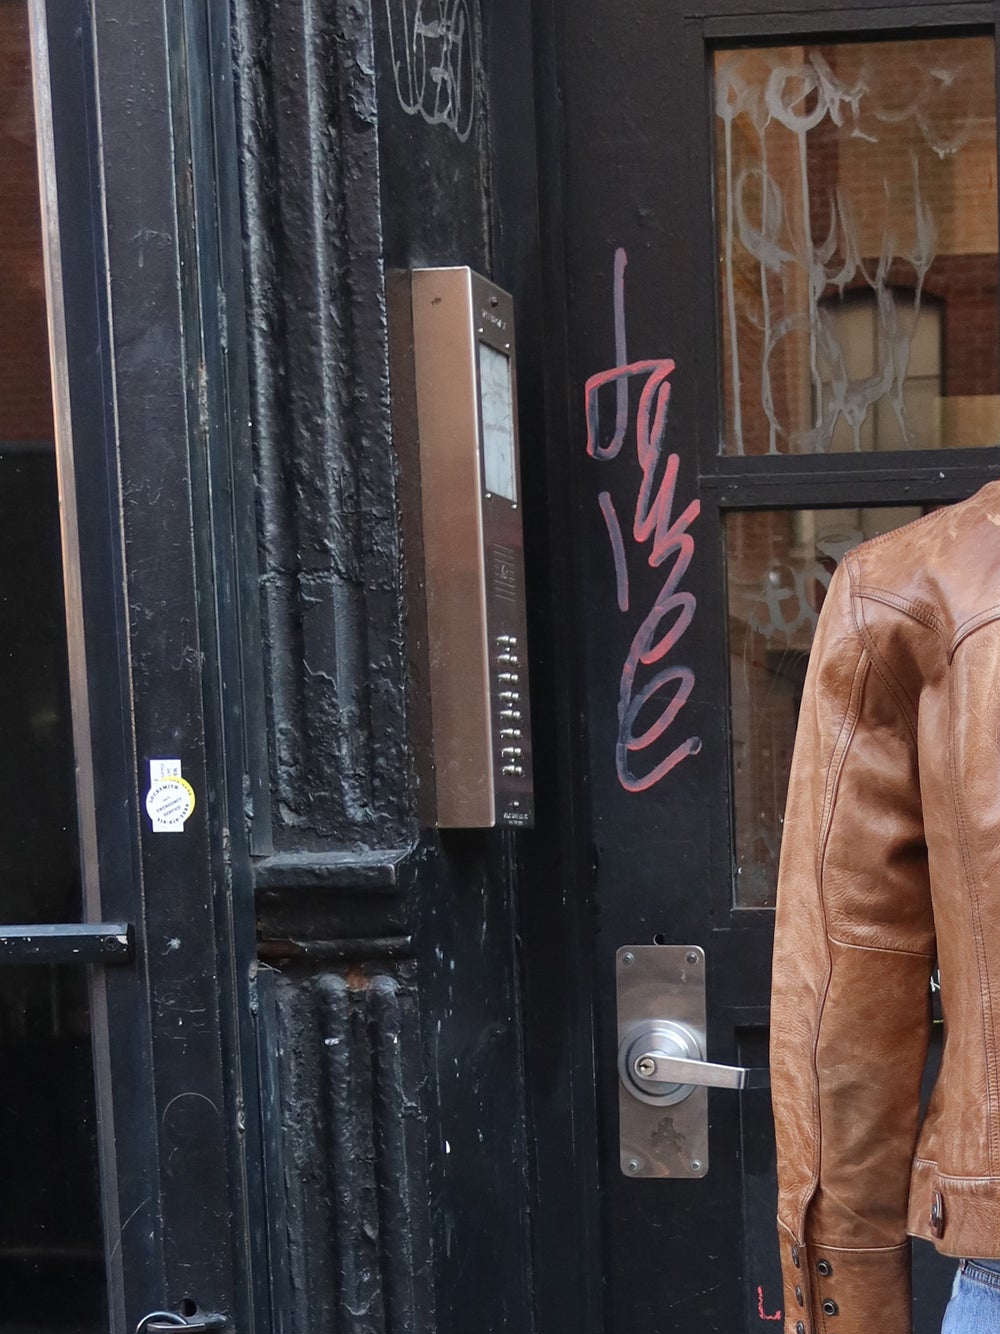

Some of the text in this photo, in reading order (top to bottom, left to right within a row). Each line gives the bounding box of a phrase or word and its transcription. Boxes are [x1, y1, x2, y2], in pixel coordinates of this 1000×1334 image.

[149, 784, 179, 803] LOCKSMITH
[156, 797, 182, 813] EMERGENCY
[163, 805, 181, 817] SERVICE
